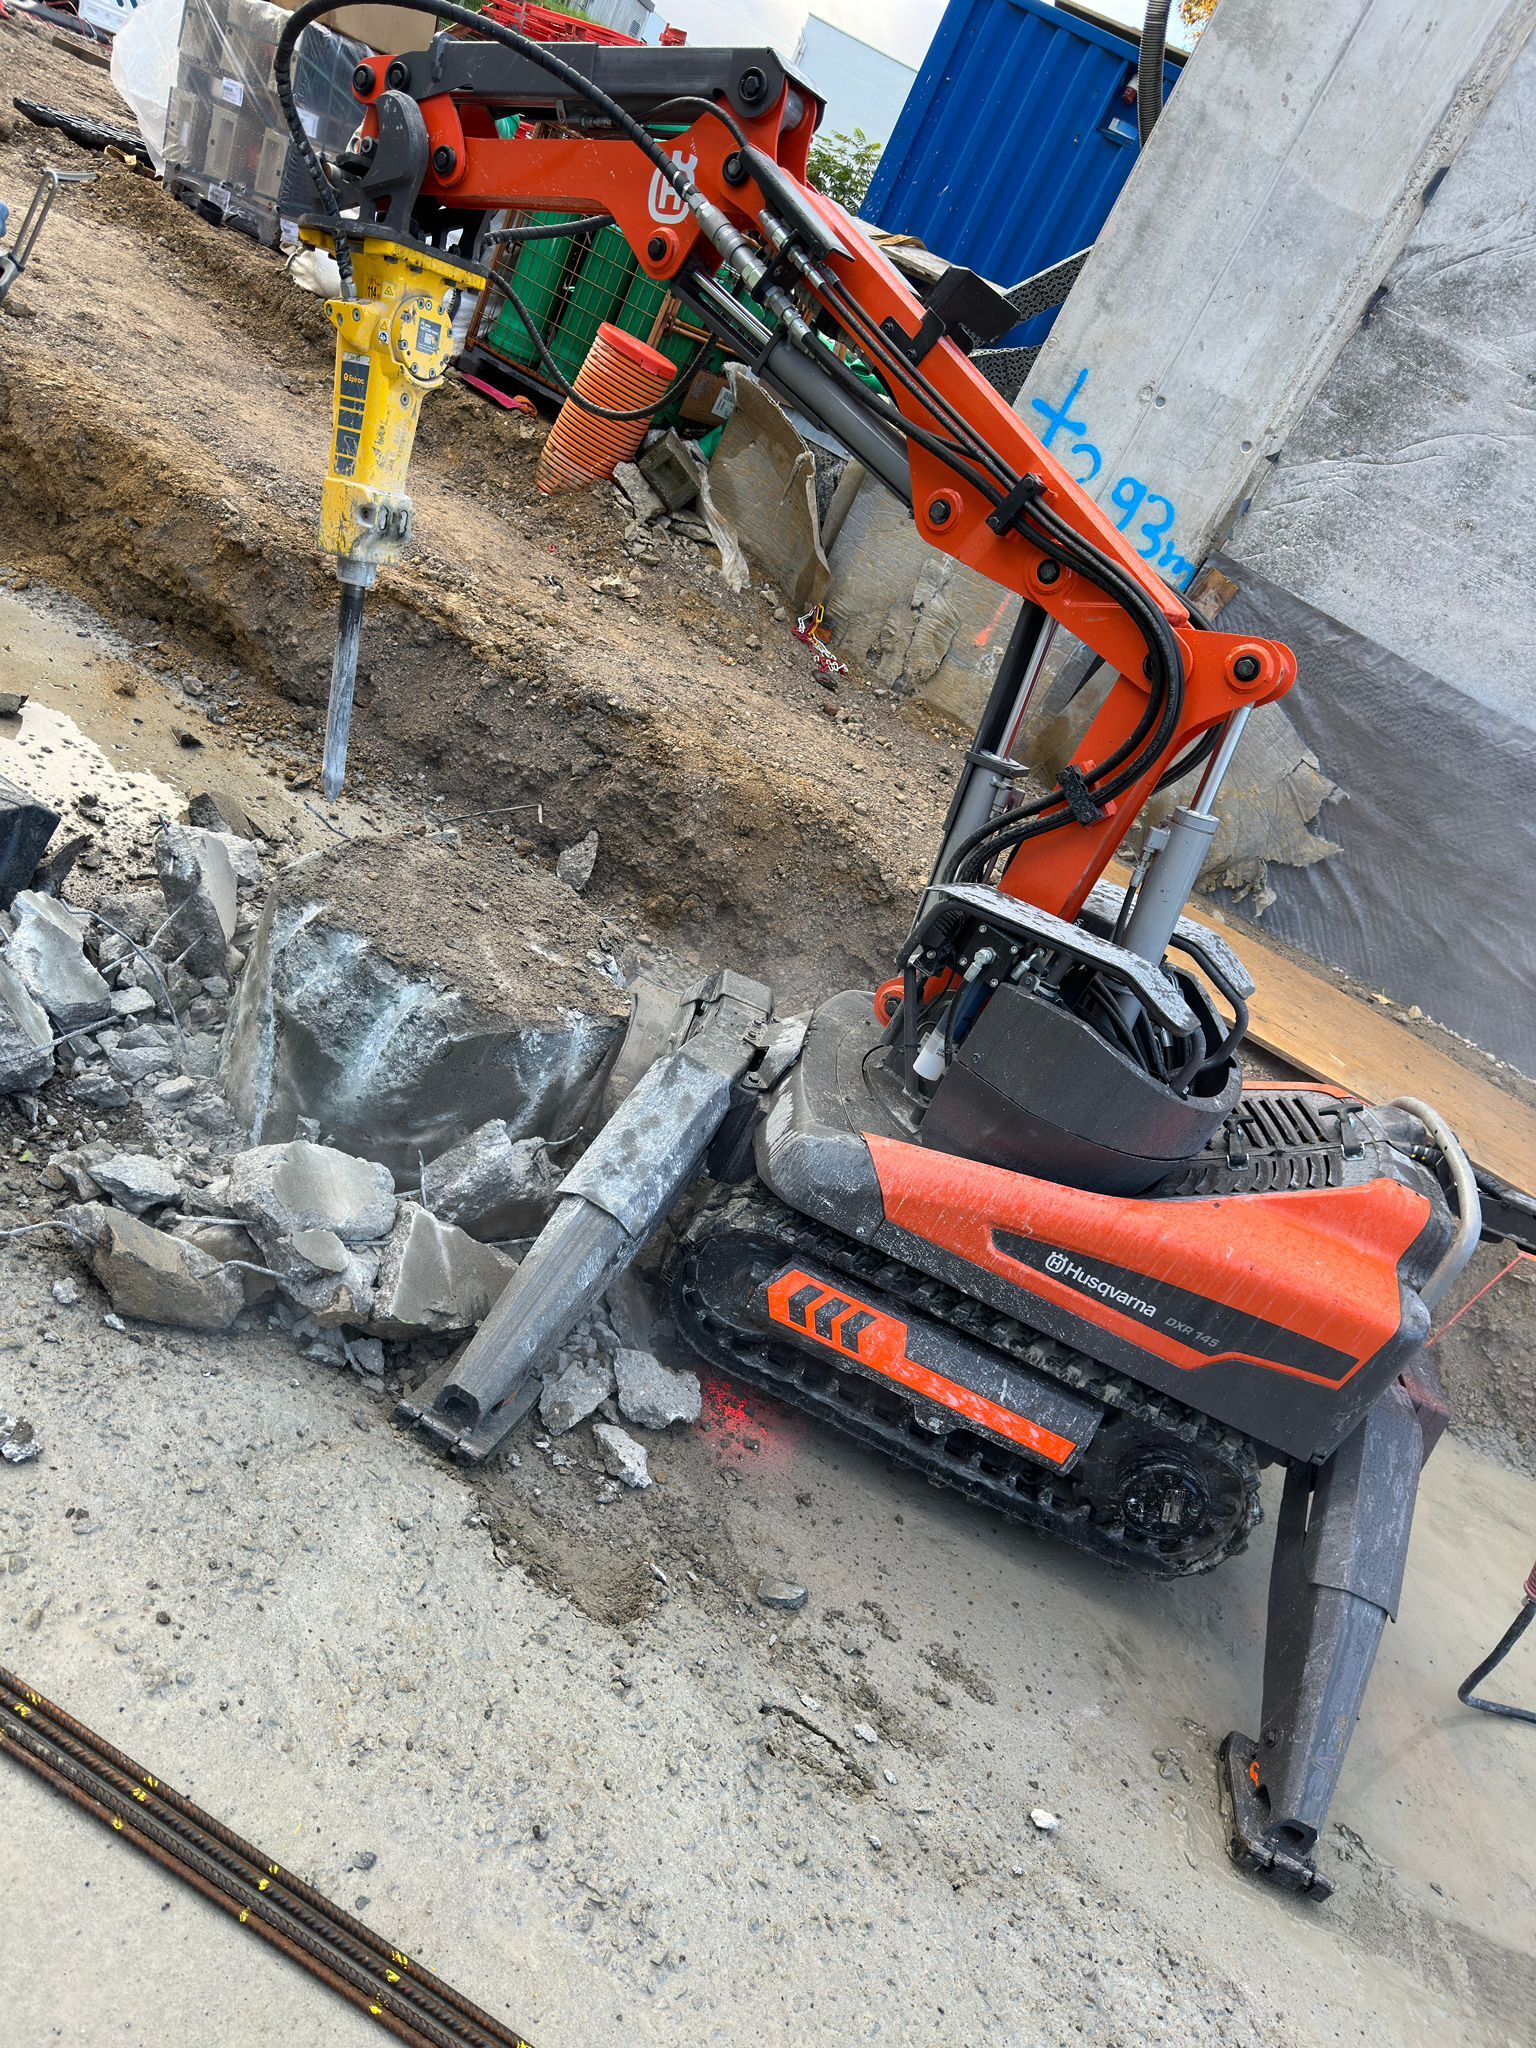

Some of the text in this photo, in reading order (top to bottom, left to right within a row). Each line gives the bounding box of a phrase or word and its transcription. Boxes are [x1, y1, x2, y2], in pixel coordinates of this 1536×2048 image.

[1064, 1262, 1157, 1318] Husqvarna
[1164, 1317, 1195, 1336] DXR
[1195, 1332, 1221, 1348] 145
